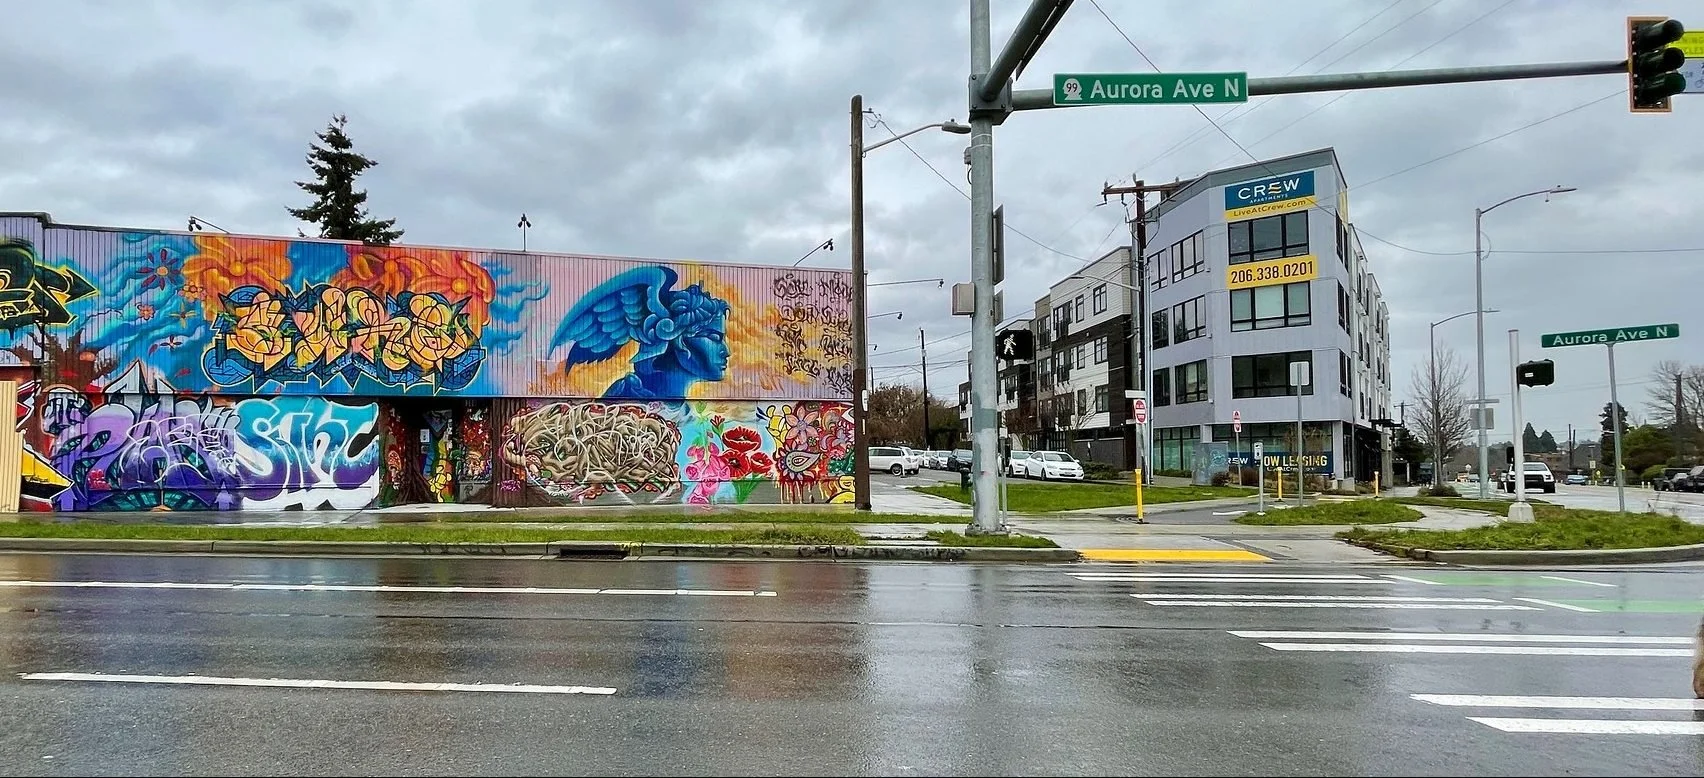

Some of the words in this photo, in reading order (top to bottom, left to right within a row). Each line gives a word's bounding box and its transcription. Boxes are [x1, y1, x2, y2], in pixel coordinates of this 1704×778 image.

[1066, 82, 1078, 93] 99
[1090, 79, 1163, 99] Aurora
[1173, 79, 1215, 98] Ave
[1224, 78, 1239, 97] N
[1237, 178, 1300, 200] CREW
[1249, 193, 1289, 204] APARTMENTS
[1233, 200, 1306, 217] LiveAtCrew.com
[1231, 261, 1313, 284] 206.338.0201
[1553, 333, 1608, 346] Aurora
[1615, 329, 1649, 341] Ave
[1656, 326, 1668, 338] N
[1260, 455, 1280, 467] OW
